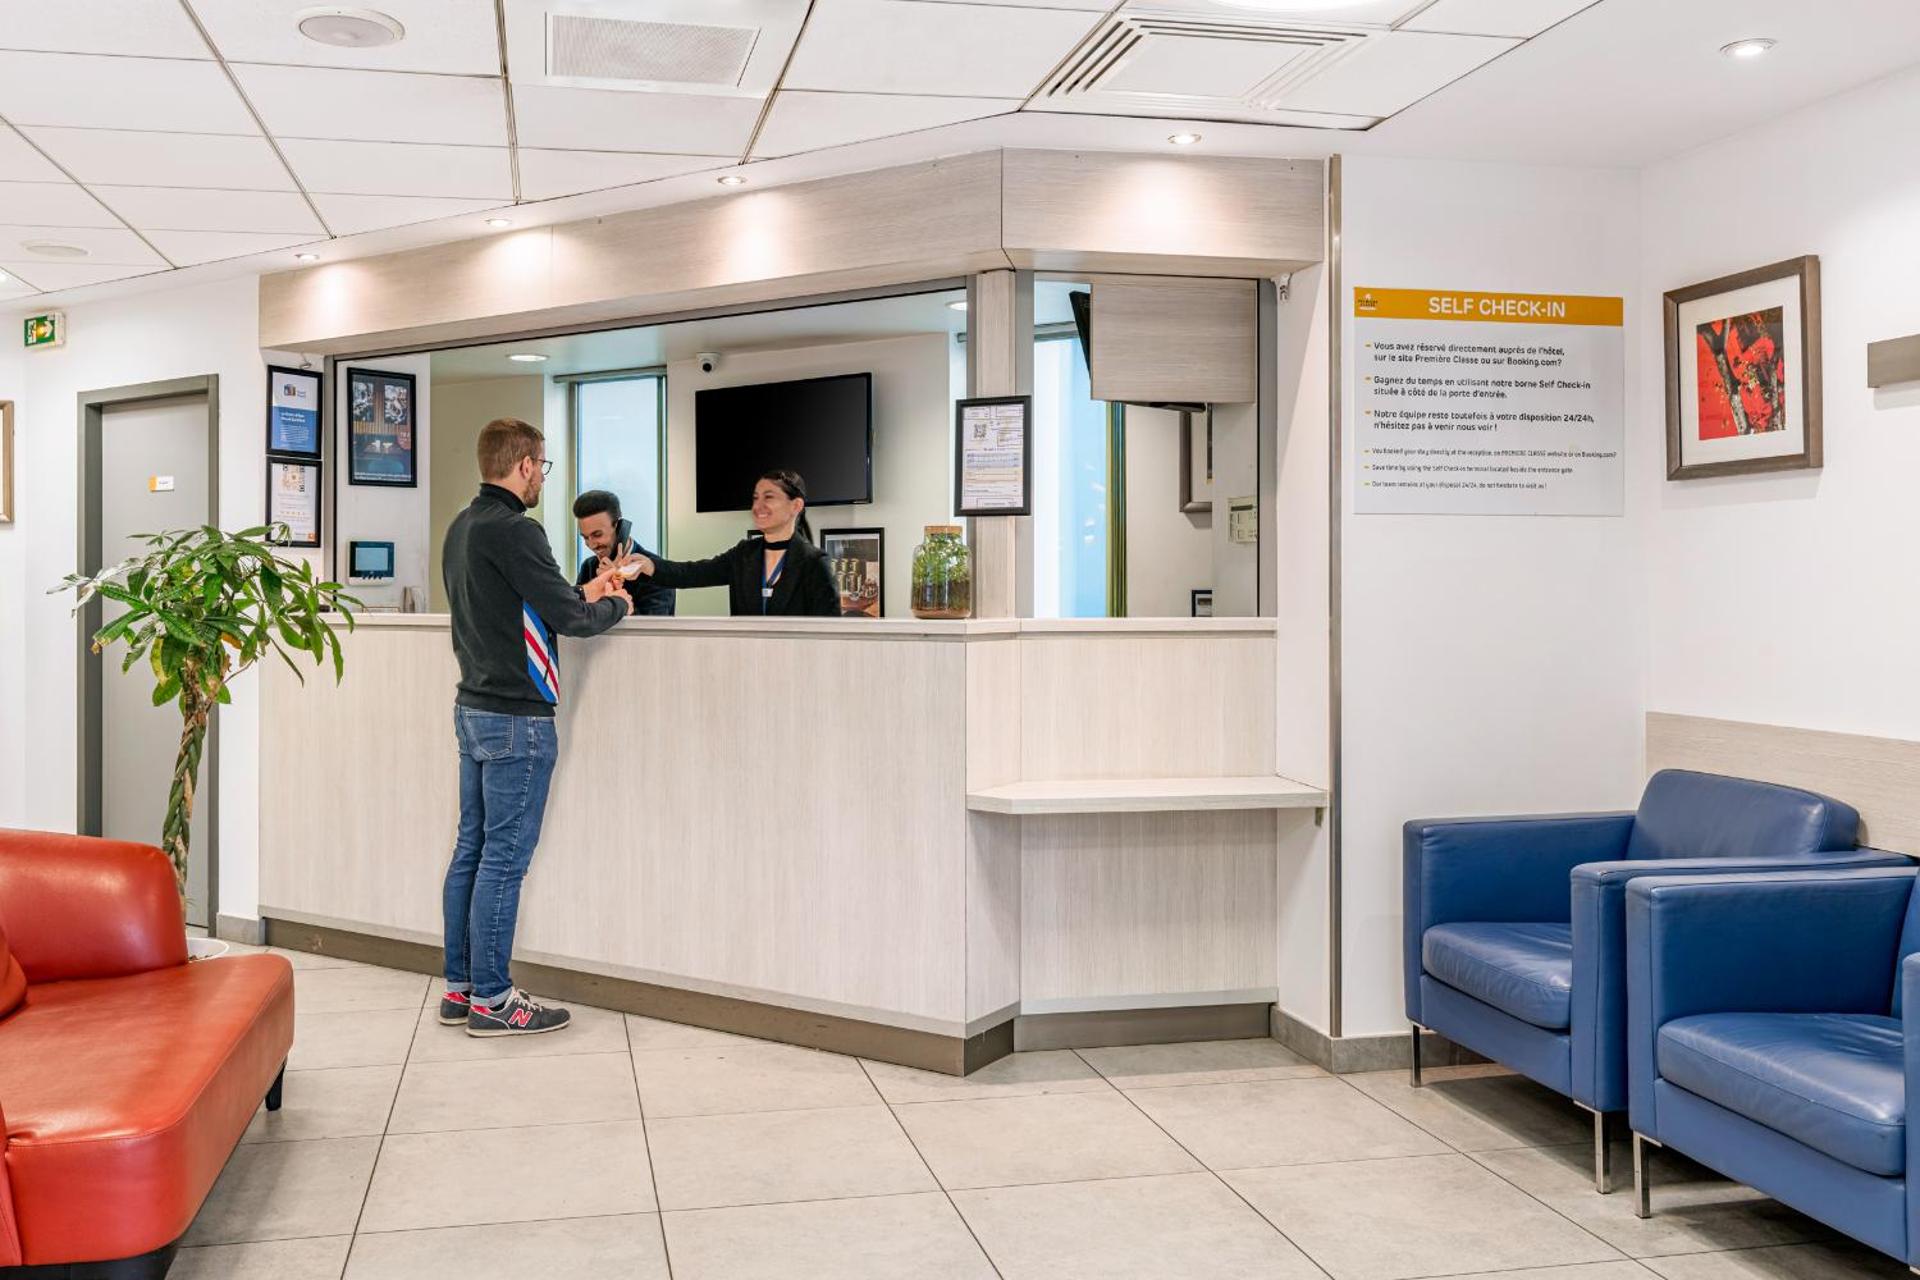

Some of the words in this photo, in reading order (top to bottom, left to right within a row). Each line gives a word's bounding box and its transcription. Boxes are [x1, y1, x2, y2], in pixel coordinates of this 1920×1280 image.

[1428, 297, 1474, 315] SELF
[1478, 299, 1566, 318] CHECK-IN
[1417, 343, 1445, 351] réservé
[1448, 344, 1496, 353] directement
[1499, 346, 1525, 355] auprès
[1538, 347, 1564, 356] l'hôtel,
[1398, 354, 1413, 362] site
[1415, 354, 1451, 363] Première
[1453, 355, 1478, 363] Classe
[1508, 358, 1562, 367] Booking.com?
[1374, 376, 1404, 385] Gagnez
[1418, 377, 1442, 386] temps
[1456, 378, 1489, 387] utilisant
[1515, 380, 1537, 388] borne
[1539, 380, 1555, 388] Self
[1557, 381, 1590, 389] Check-in
[1401, 388, 1405, 396] à
[1408, 388, 1425, 396] côté
[1449, 389, 1470, 398] porte
[1472, 388, 1507, 399] d'entrée.
[1399, 410, 1426, 419] équipe
[1451, 411, 1488, 420] toutefois
[1489, 412, 1494, 420] à
[1519, 413, 1562, 422] disposition
[1564, 414, 1594, 423] 24/24h,
[1374, 421, 1409, 429] n'hésitez
[1412, 422, 1425, 431] pas
[508, 1008, 533, 1027] N
